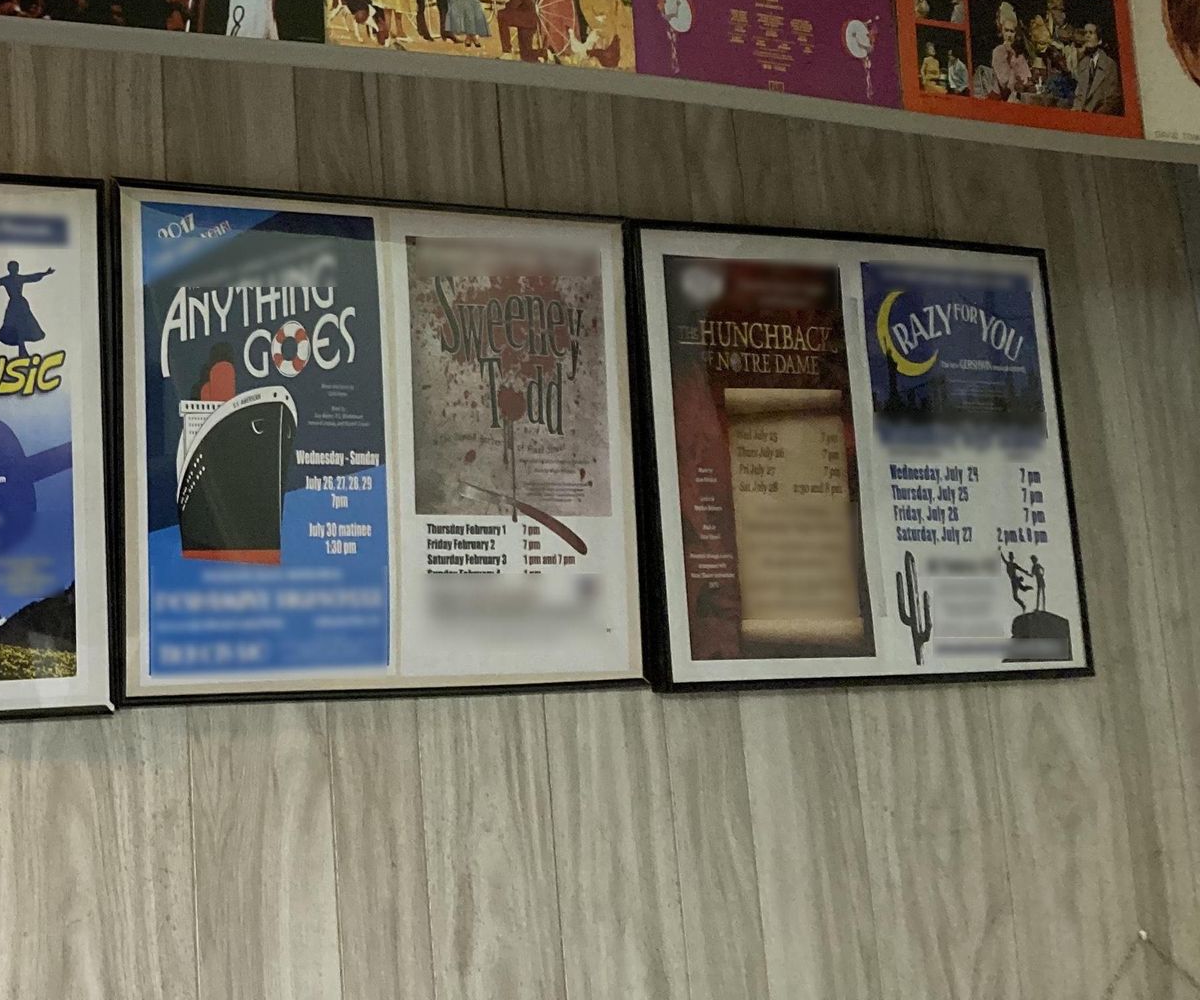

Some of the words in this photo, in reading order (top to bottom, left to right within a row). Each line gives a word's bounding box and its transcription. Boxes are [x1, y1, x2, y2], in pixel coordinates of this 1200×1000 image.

[161, 285, 334, 378] ANYTHING
[434, 276, 584, 381] Sweeney
[699, 319, 833, 352] HUNCHBACK
[954, 303, 978, 324] FOR
[979, 309, 1024, 362] YOU
[244, 306, 356, 378] GOES
[716, 351, 771, 374] NOTRE
[775, 354, 820, 376] DAME
[296, 450, 344, 466] Wednesday
[350, 450, 380, 467] Sunday
[306, 475, 321, 491] July
[944, 465, 963, 484] July
[967, 466, 979, 482] 24
[1027, 470, 1041, 486] pm
[331, 493, 349, 509] 7pm
[937, 485, 955, 504] July
[926, 505, 945, 524] July
[309, 522, 325, 539] July
[326, 522, 337, 536] 30
[338, 522, 372, 538] matinee
[427, 523, 465, 536] Thursday
[466, 524, 501, 537] February
[941, 526, 960, 545] July
[325, 540, 342, 555] 1:30
[427, 539, 452, 551] Friday
[454, 539, 489, 551] February
[427, 554, 464, 566] Saturday
[465, 554, 501, 566] February
